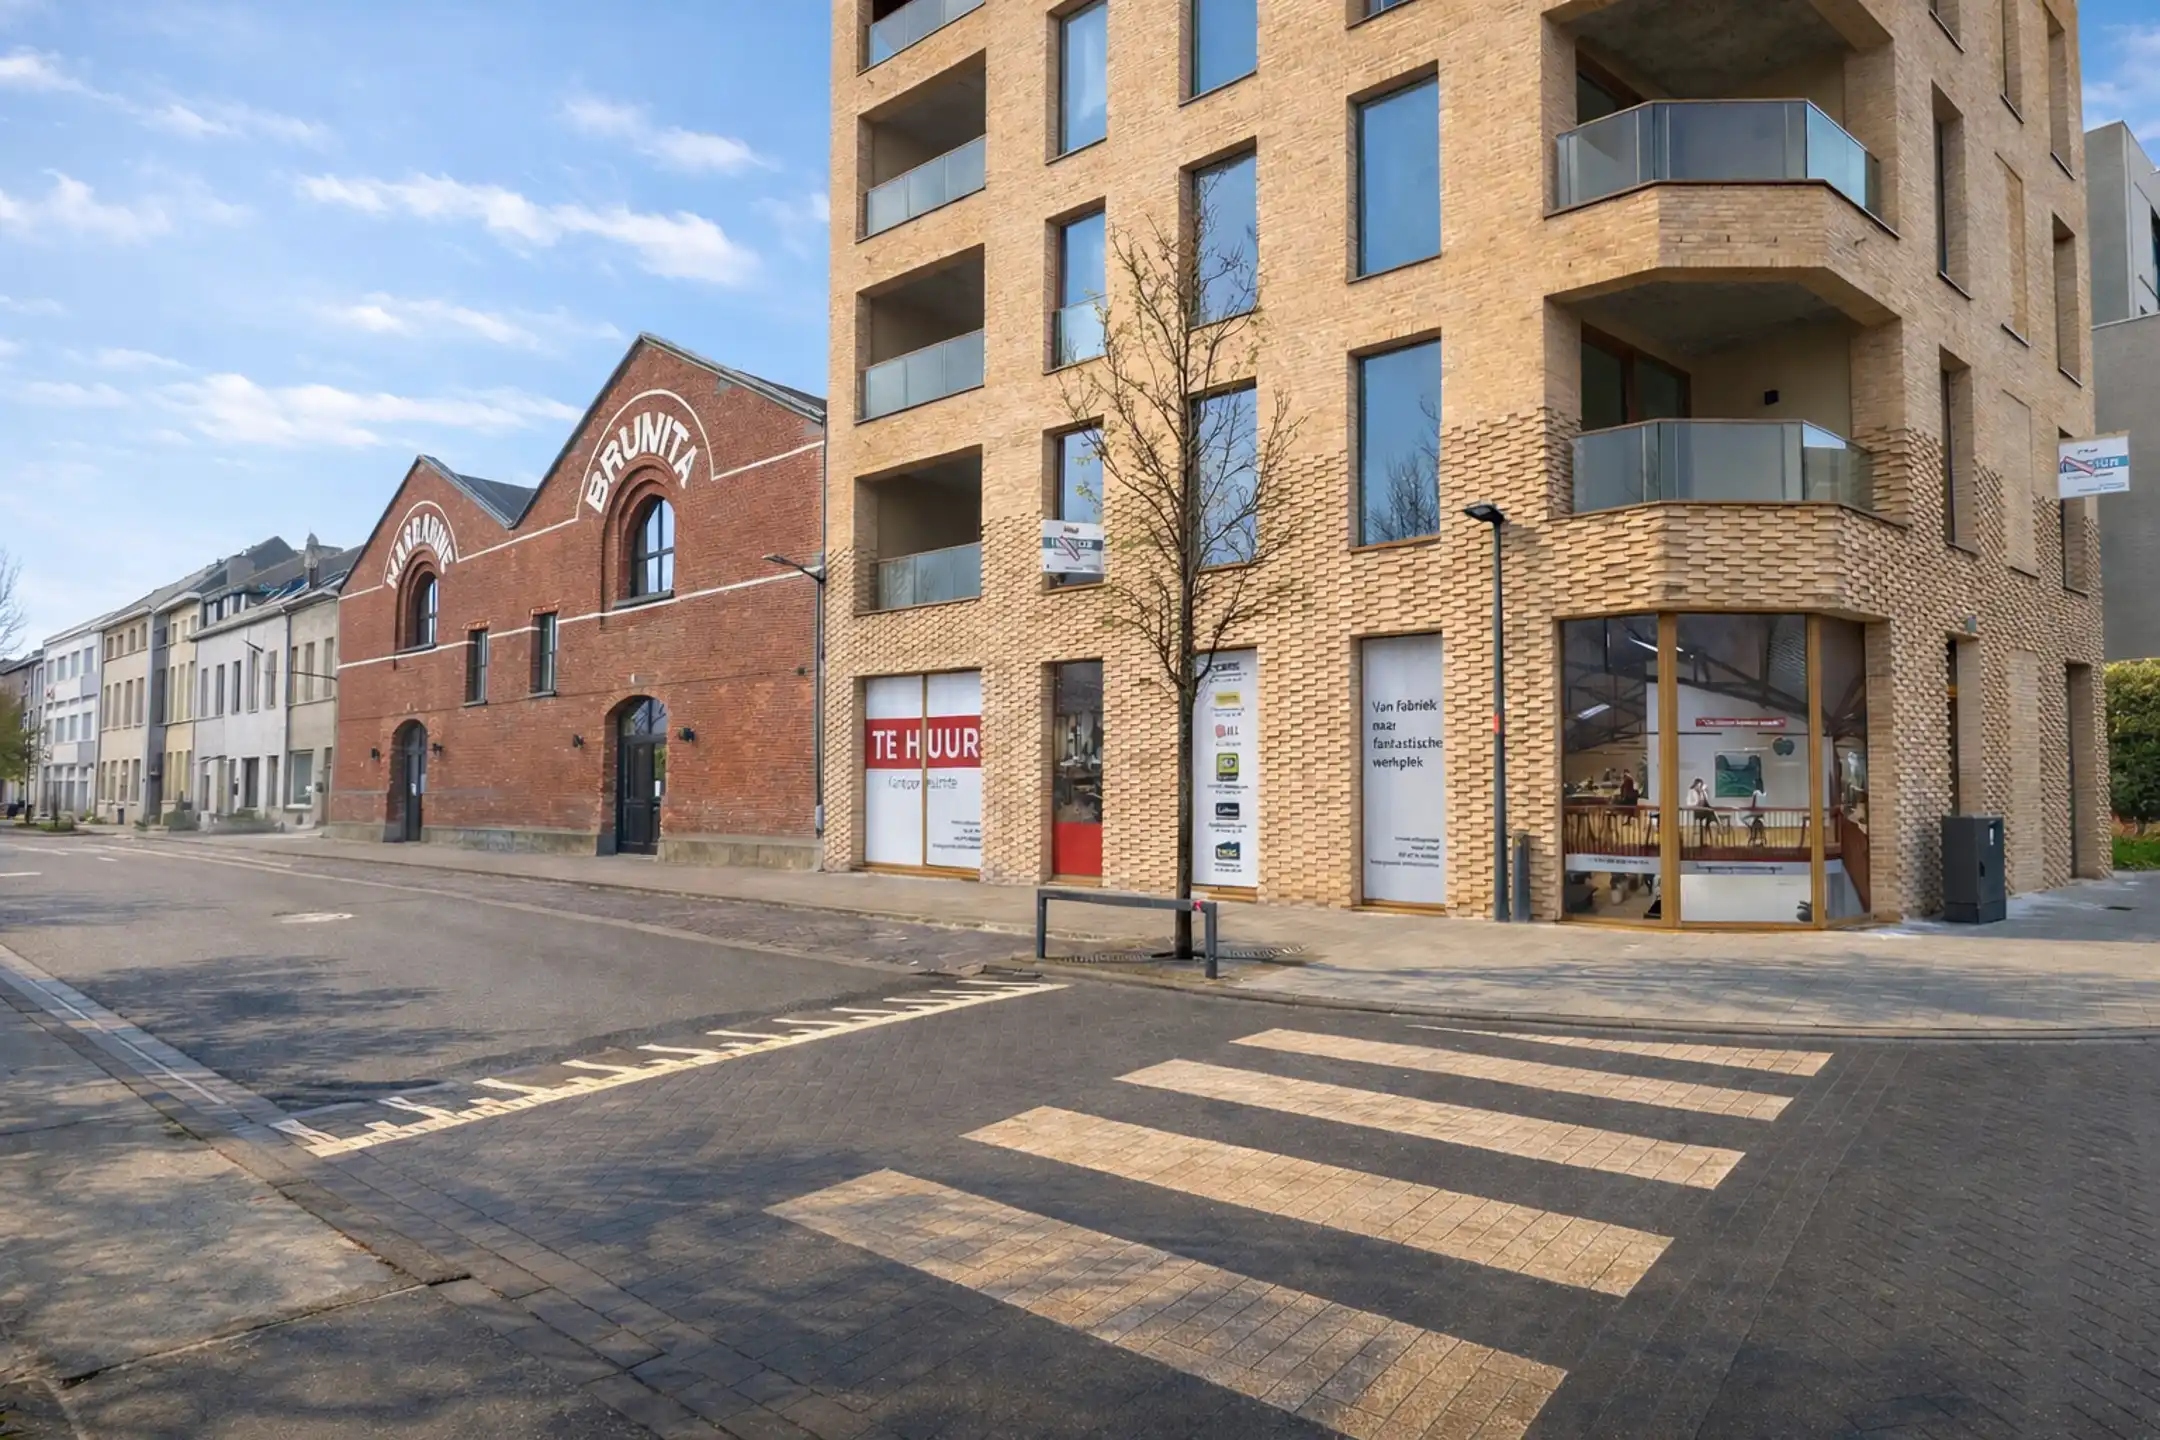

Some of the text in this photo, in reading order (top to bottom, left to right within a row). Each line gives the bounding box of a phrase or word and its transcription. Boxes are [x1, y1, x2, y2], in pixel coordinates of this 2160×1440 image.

[585, 411, 698, 514] BRUNITA
[1372, 699, 1437, 713] Van fabriek
[1372, 721, 1396, 731] naar
[872, 727, 980, 760] TE HUUR
[1373, 736, 1443, 750] fantastische
[1372, 756, 1423, 771] werkplek
